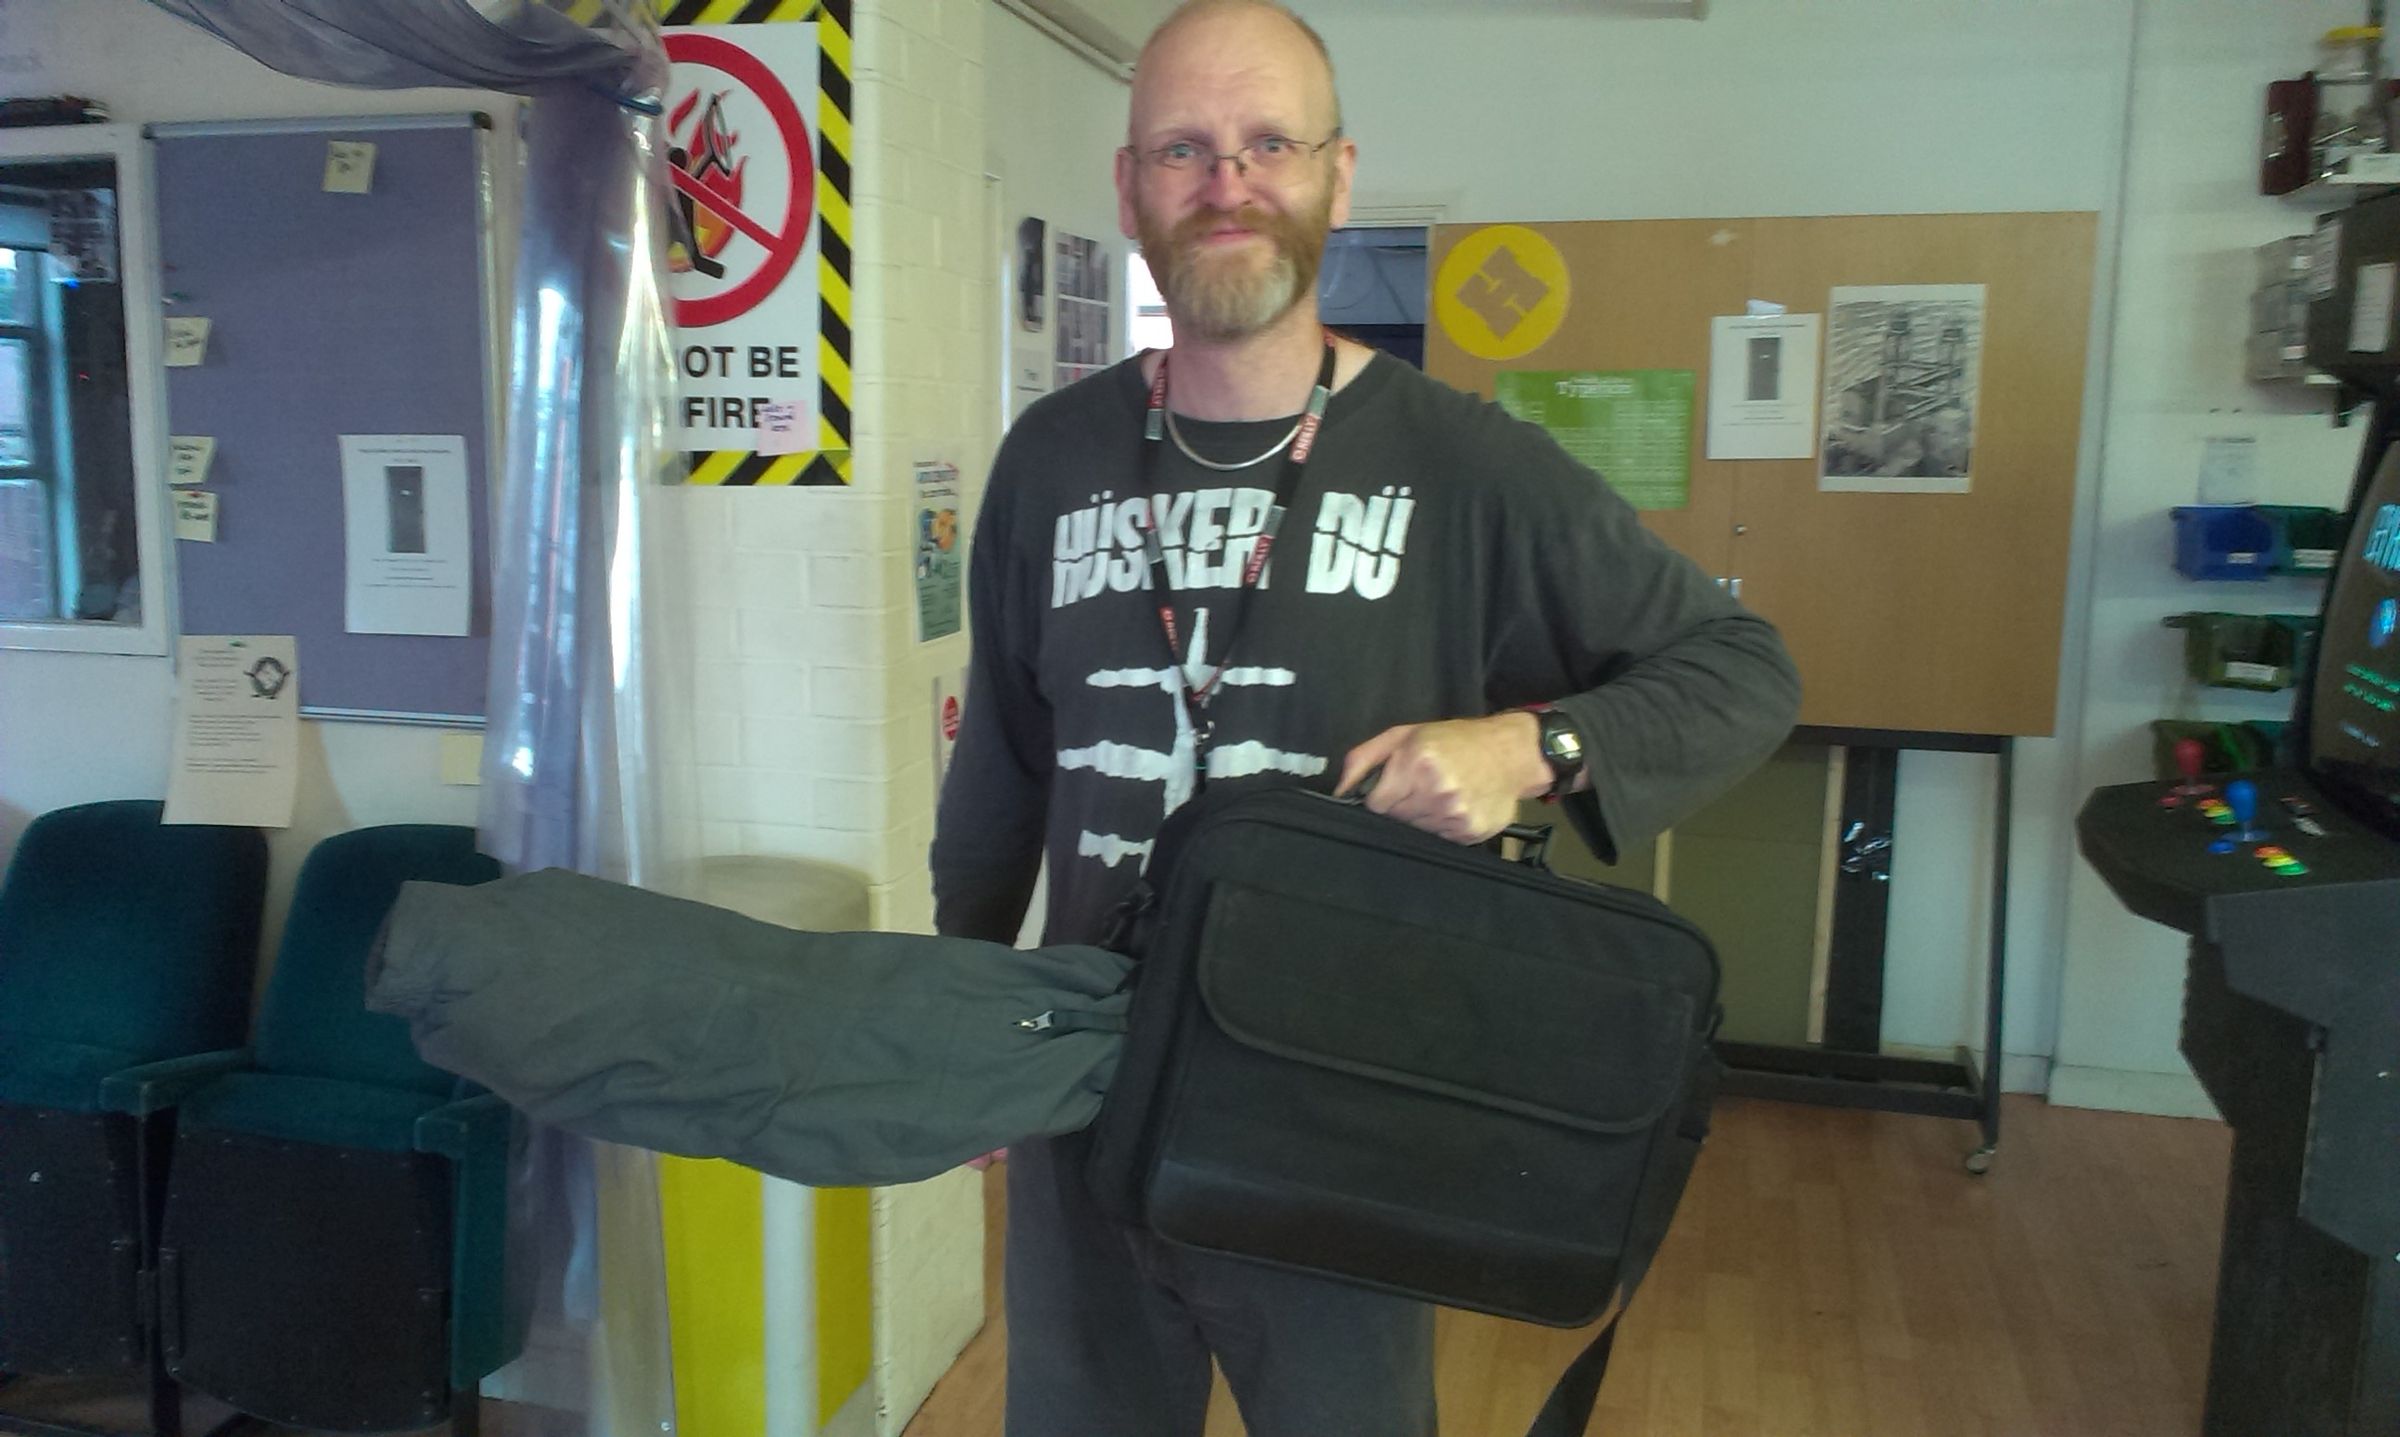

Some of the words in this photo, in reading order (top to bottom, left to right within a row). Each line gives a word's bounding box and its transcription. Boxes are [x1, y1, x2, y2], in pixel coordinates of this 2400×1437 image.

[676, 345, 735, 378] OT
[748, 345, 800, 378] BE
[1305, 484, 1416, 601] DÜ
